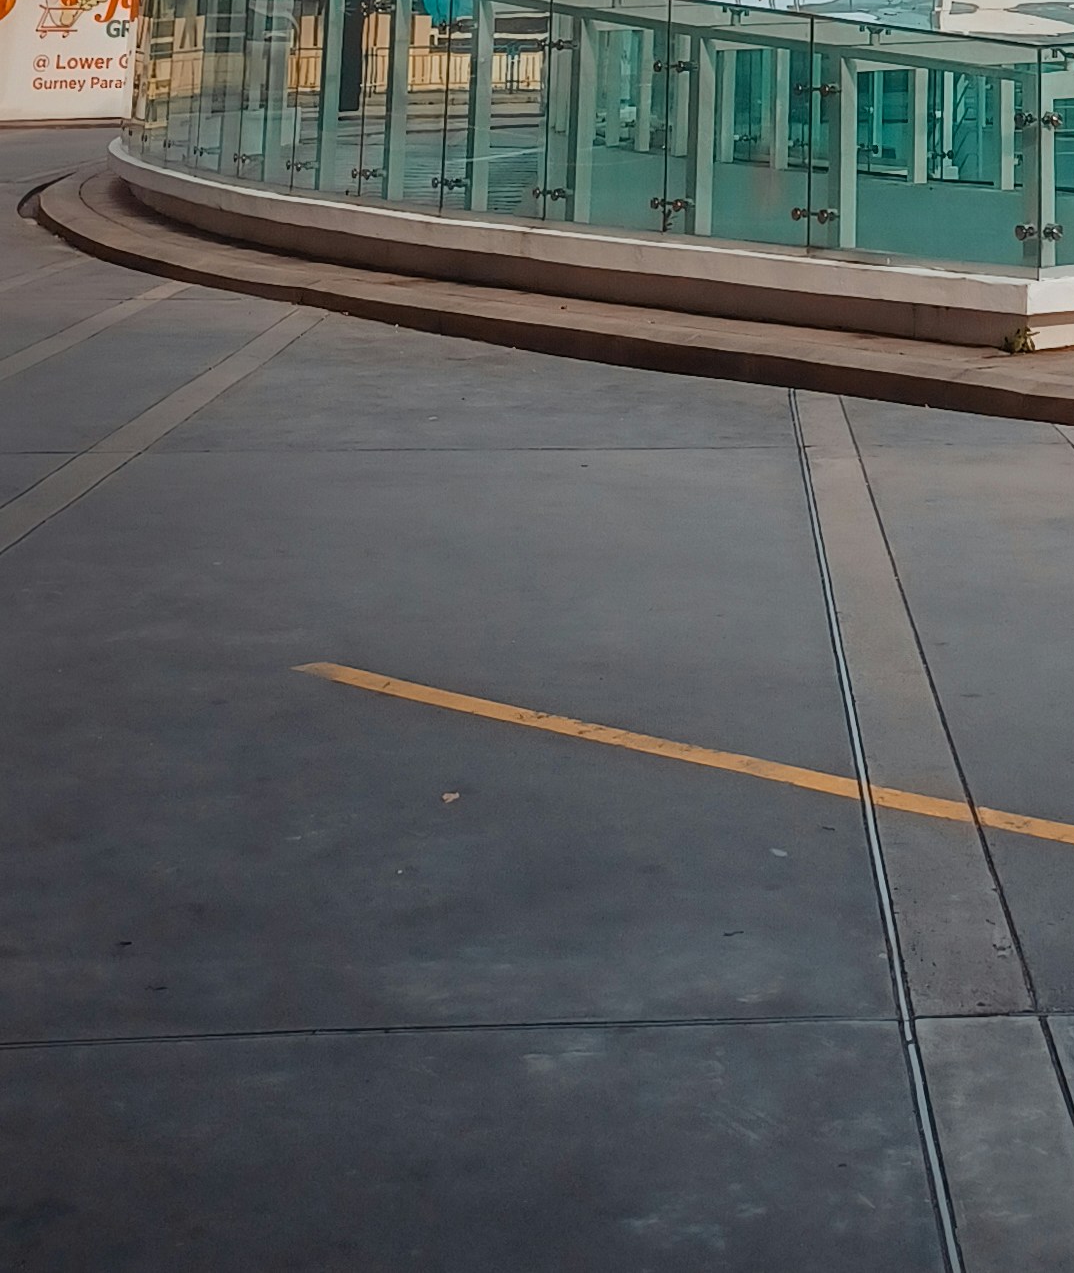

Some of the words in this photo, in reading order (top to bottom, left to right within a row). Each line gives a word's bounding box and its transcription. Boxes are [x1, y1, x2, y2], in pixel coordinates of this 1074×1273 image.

[33, 54, 50, 73] @
[55, 54, 113, 70] Lower
[32, 77, 86, 92] Gurney
[90, 76, 126, 90] Para
